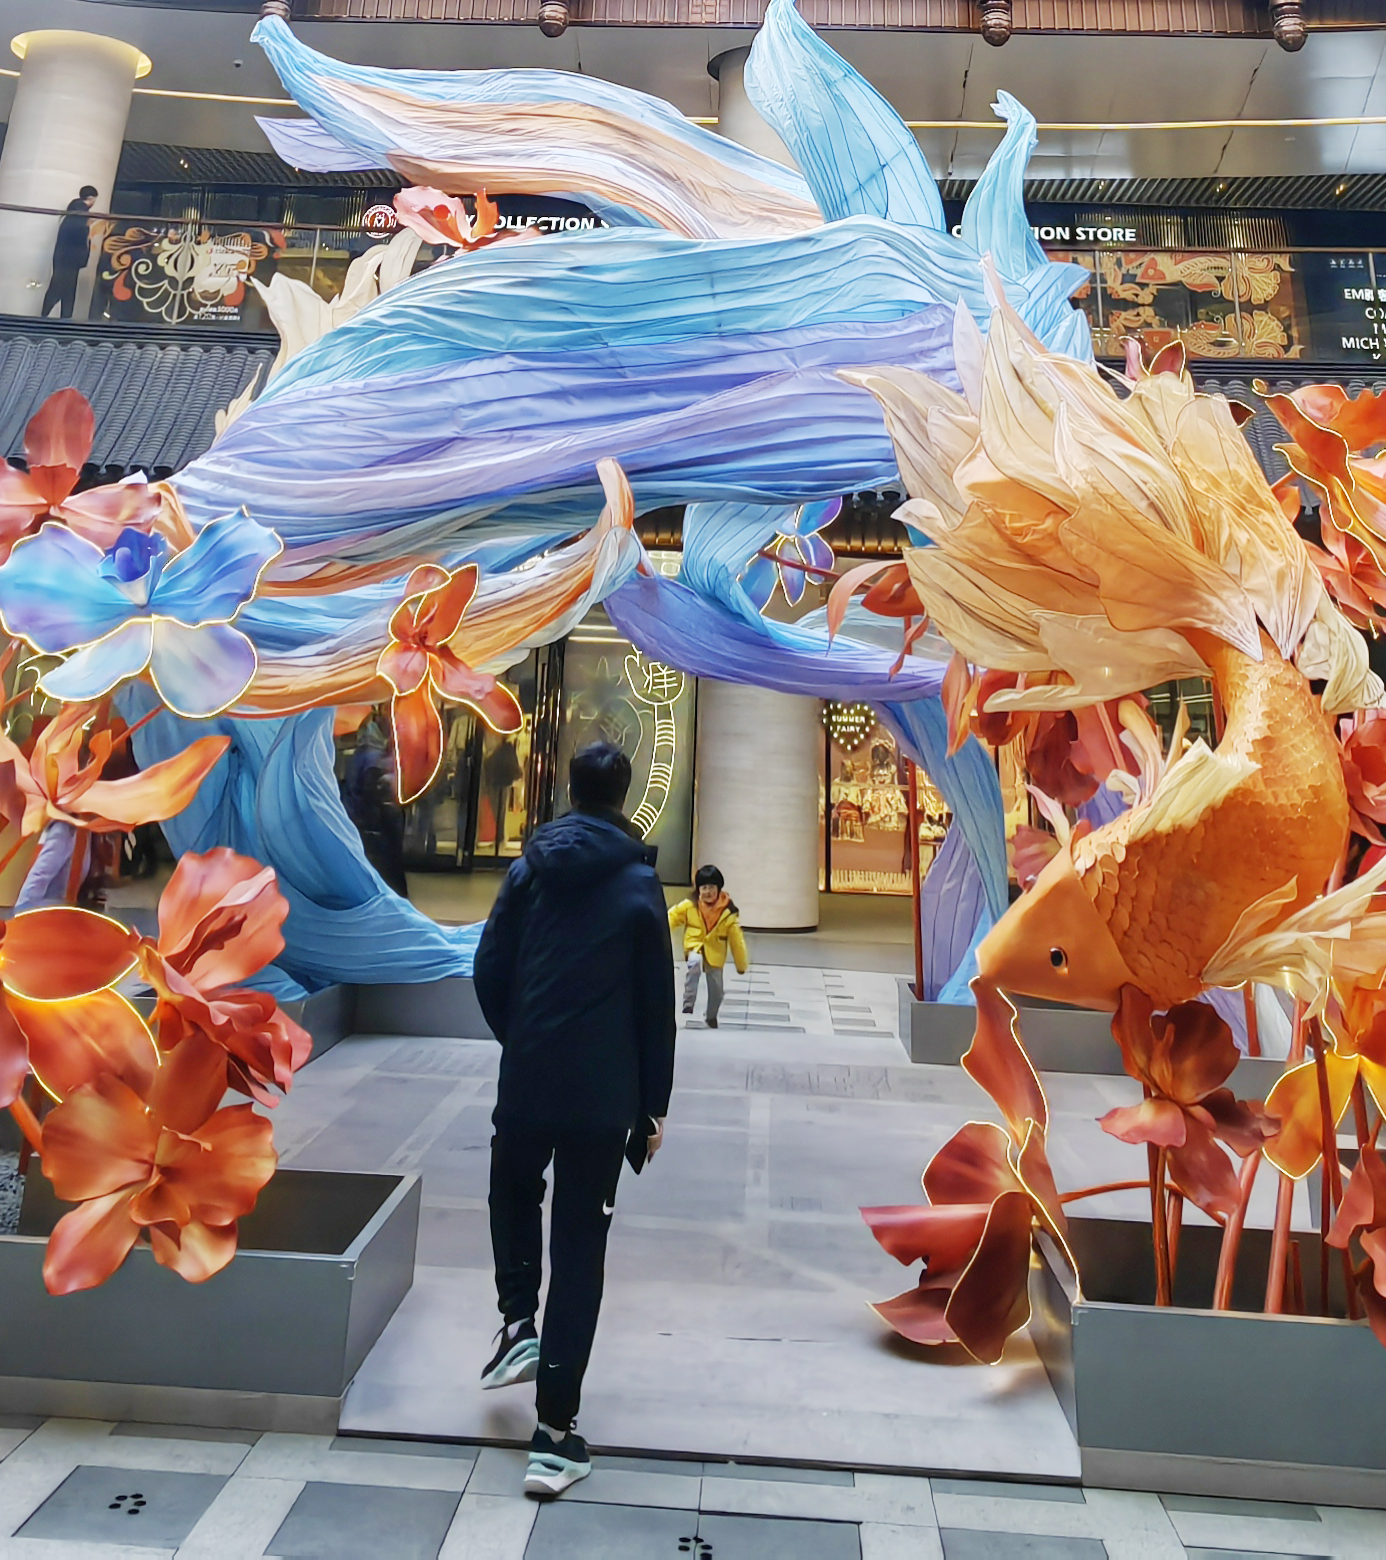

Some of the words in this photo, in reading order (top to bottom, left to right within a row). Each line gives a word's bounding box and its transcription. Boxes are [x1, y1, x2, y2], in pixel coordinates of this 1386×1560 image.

[494, 214, 595, 231] OLLECTION
[1075, 226, 1137, 242] STORE
[832, 715, 866, 724] SUMMER
